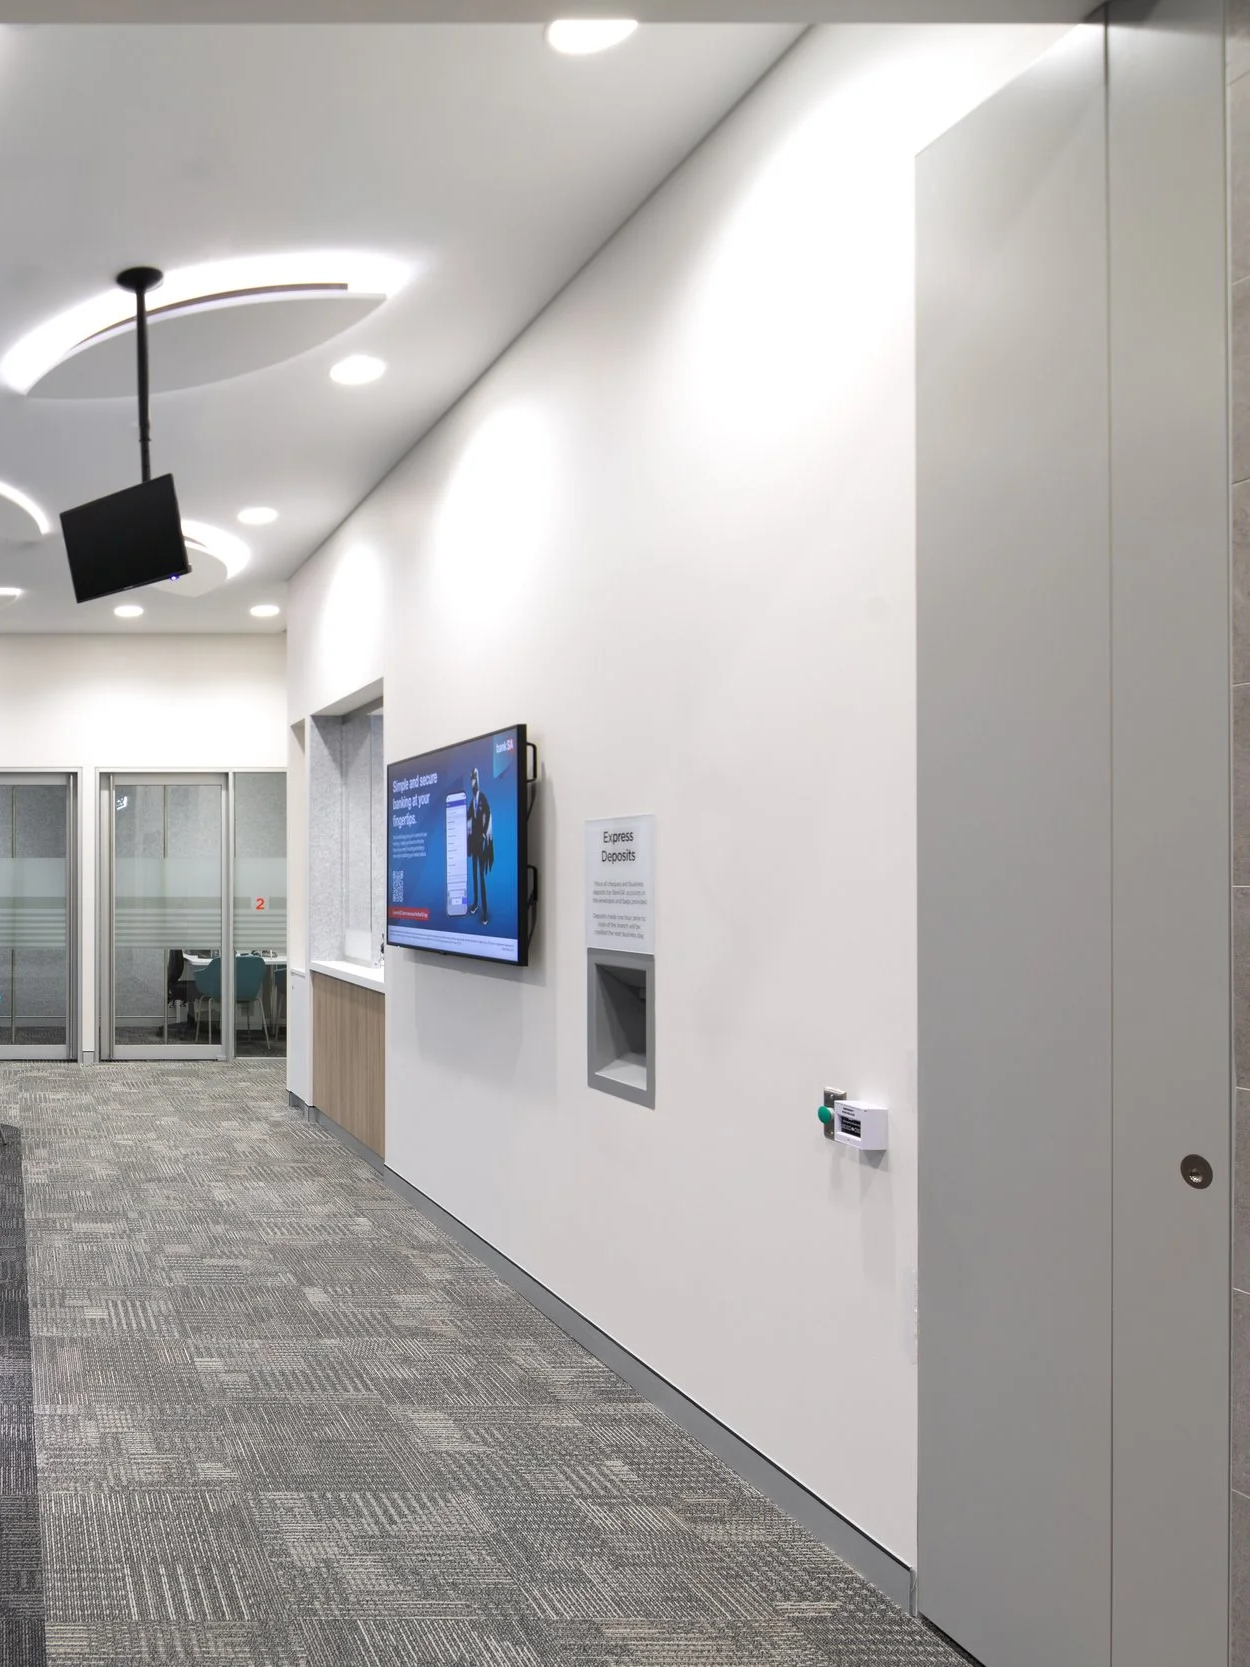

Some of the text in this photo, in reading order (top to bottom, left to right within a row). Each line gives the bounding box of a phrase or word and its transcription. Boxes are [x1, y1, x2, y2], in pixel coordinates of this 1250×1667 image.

[393, 772, 438, 793] Simple and secure
[393, 793, 430, 810] banking at your
[393, 812, 417, 829] fingertips.
[603, 831, 634, 845] Express
[601, 849, 636, 864] Deposits
[255, 898, 265, 910] 2
